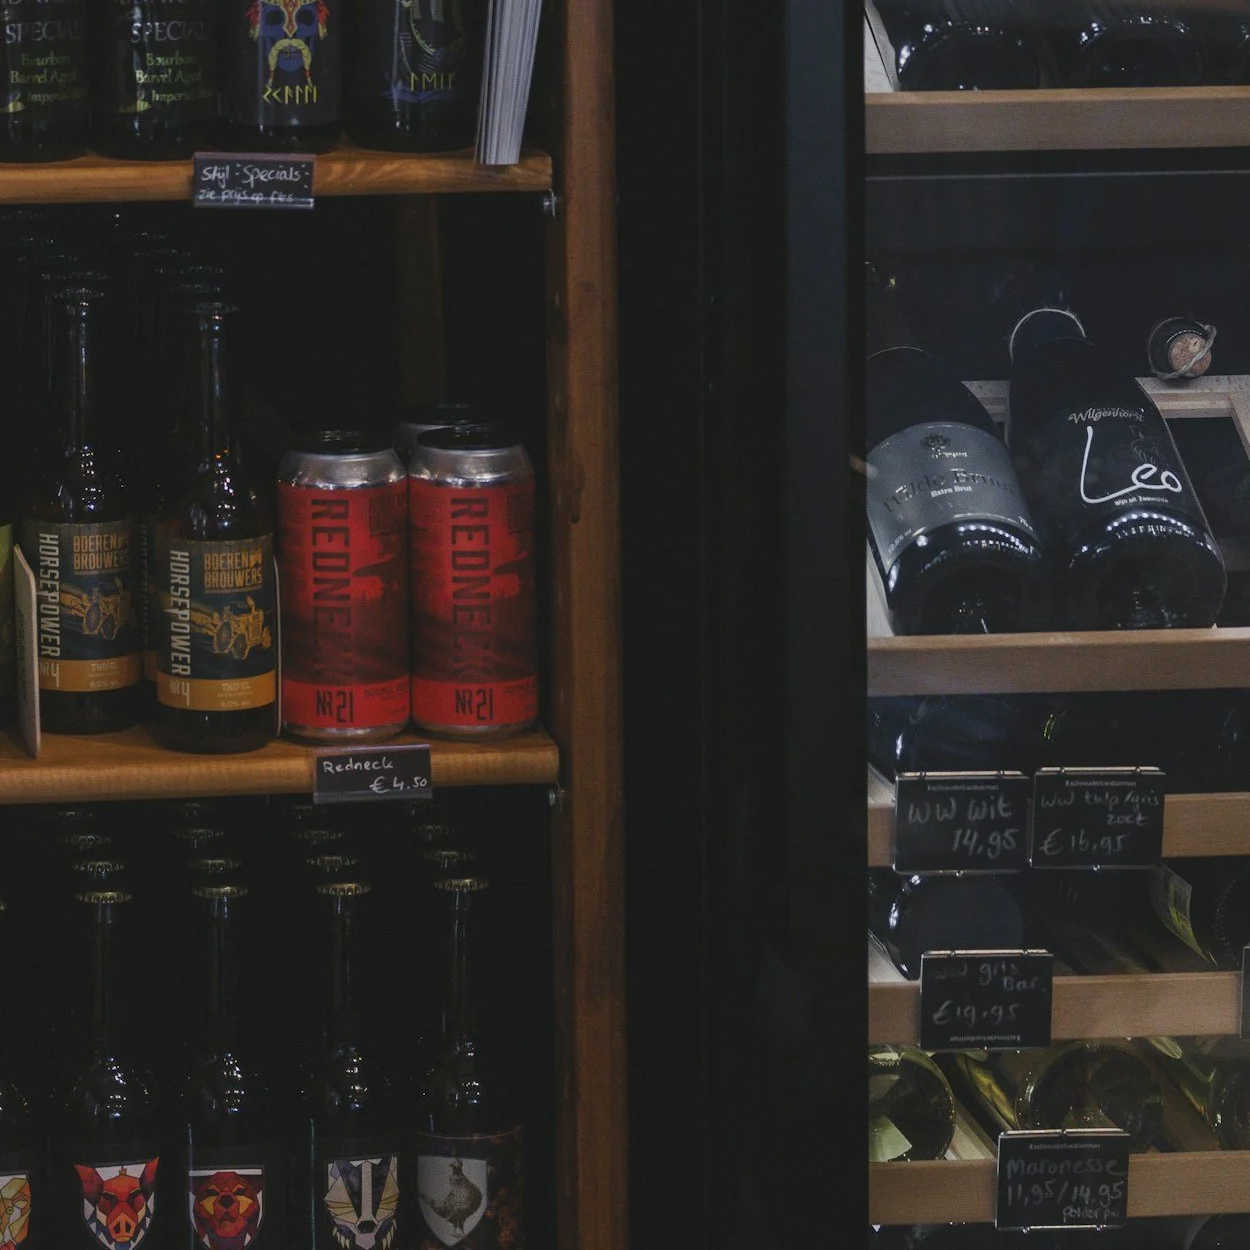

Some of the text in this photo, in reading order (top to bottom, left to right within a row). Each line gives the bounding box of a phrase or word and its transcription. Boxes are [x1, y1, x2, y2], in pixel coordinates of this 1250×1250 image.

[1079, 425, 1184, 505] Leo
[205, 567, 263, 589] BROUWERS
[38, 533, 62, 658] HORSEPOWER
[169, 550, 192, 677] HORSEPOWER
[336, 691, 355, 723] 21
[476, 687, 494, 721] 21
[322, 756, 395, 775] Redneck
[369, 775, 388, 793] €
[1042, 828, 1065, 855] €
